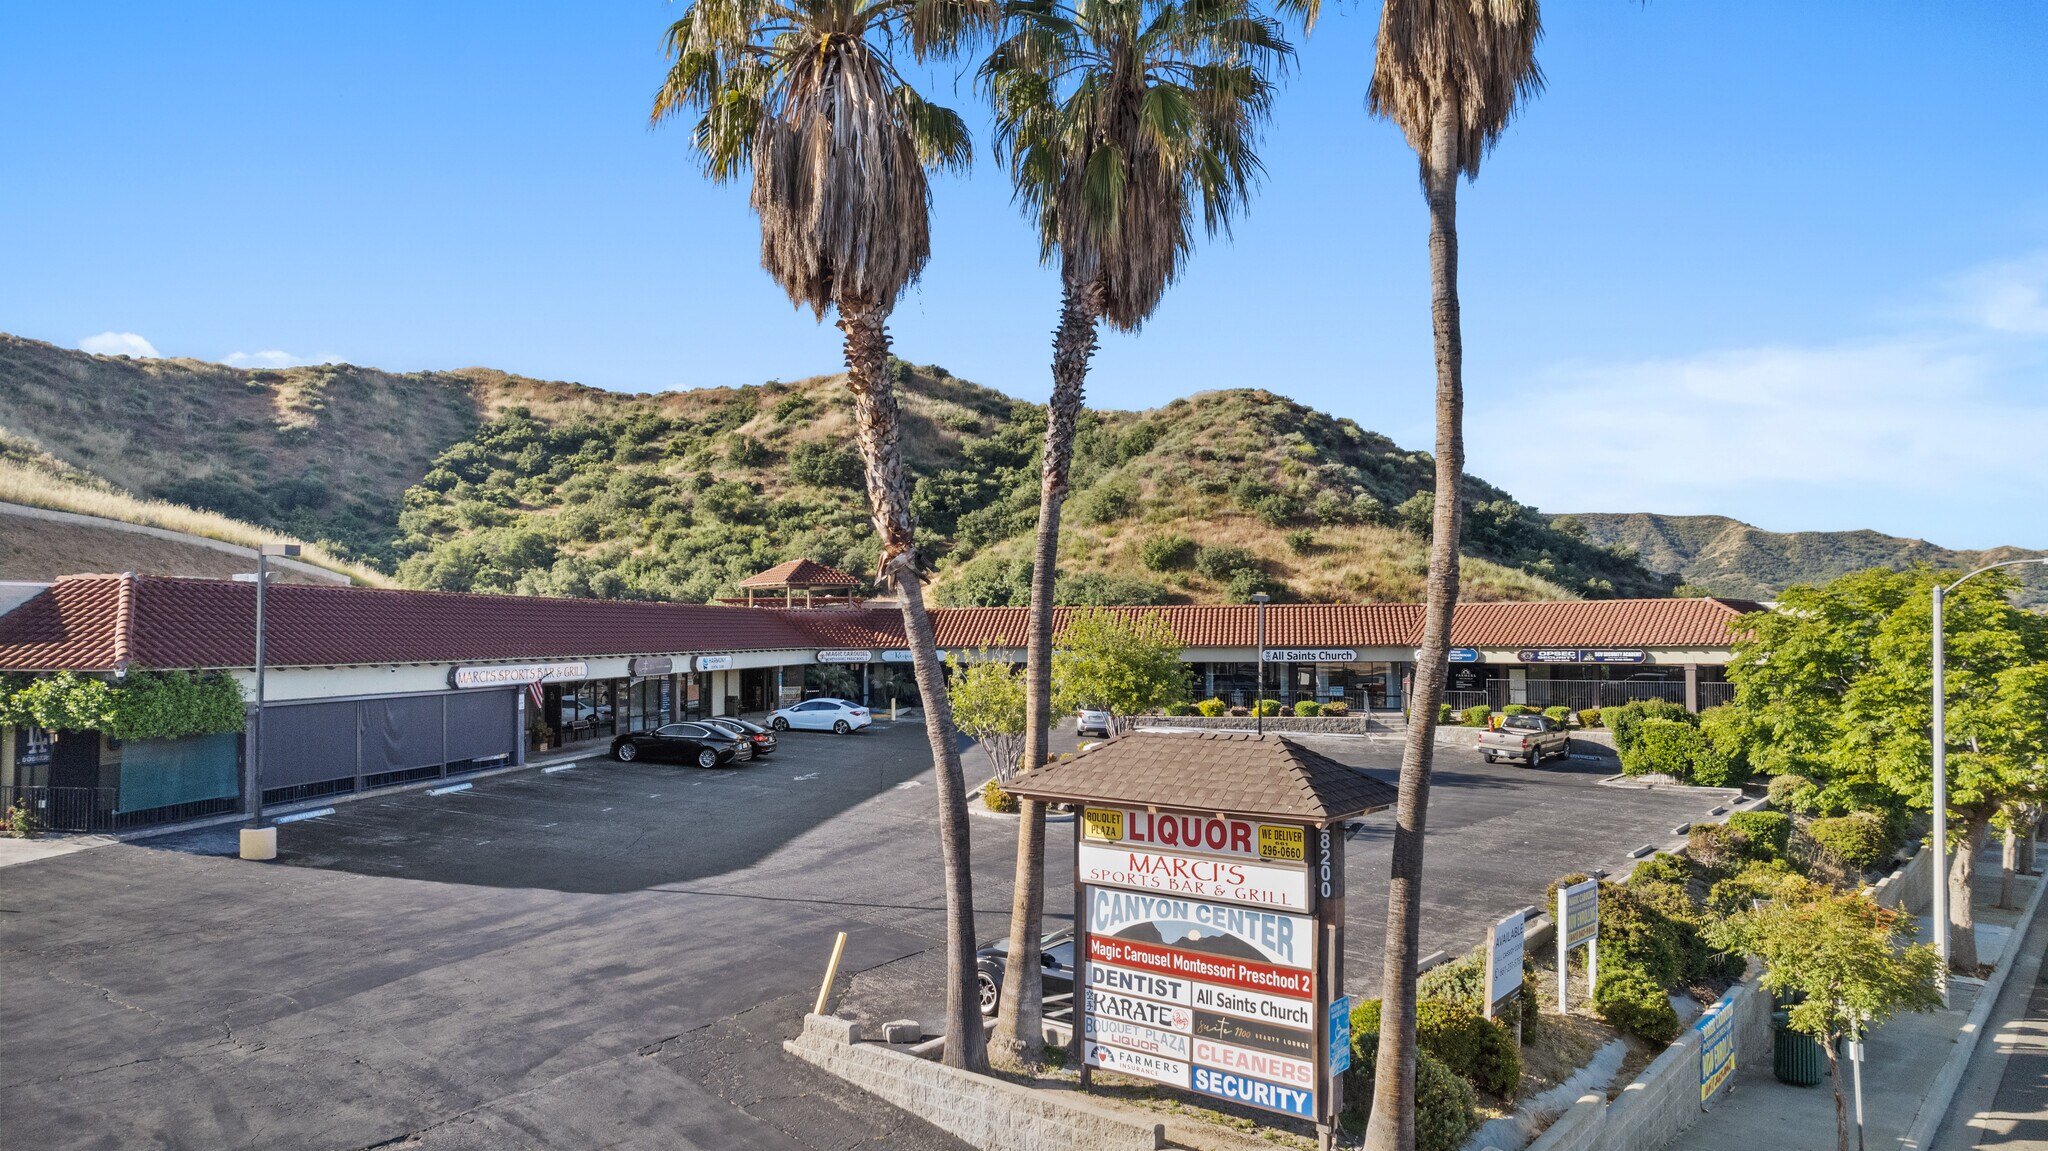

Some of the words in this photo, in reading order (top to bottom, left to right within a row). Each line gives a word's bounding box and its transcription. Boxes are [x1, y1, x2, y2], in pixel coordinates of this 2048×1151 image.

[1272, 651, 1284, 660] All
[1286, 651, 1316, 660] Saints
[1319, 651, 1352, 660] Church
[458, 671, 496, 684] MARCI'S
[499, 668, 535, 681] SPORTS
[537, 667, 555, 679] BAR
[556, 668, 563, 678] &
[563, 665, 585, 677] GRILL
[1087, 811, 1121, 825] BOUQUET
[1091, 825, 1116, 837] PLAZA
[1129, 812, 1252, 853] LIQUOR
[1261, 828, 1272, 840] WE
[1274, 829, 1302, 842] DELIVER
[1129, 853, 1245, 885] MARCI'S
[1091, 869, 1160, 888] SPORTS
[1169, 878, 1205, 894] BAR
[1214, 885, 1225, 896] &
[1235, 888, 1292, 906] GRILL
[1095, 891, 1188, 931] CANYON
[1195, 904, 1294, 963] CENTER
[1495, 922, 1524, 948] AVAILABLE
[1091, 939, 1122, 960] Magic
[1124, 945, 1171, 968] Carousel
[1173, 954, 1235, 980] Montessori
[1239, 964, 1299, 990] Preschool
[1302, 975, 1310, 992] 2
[1092, 966, 1182, 999] DENTIST
[1093, 993, 1173, 1027] KARATE
[1196, 989, 1213, 1005] All
[1216, 992, 1257, 1014] Saints
[1260, 1000, 1308, 1024] Church
[1085, 1017, 1140, 1036] BOUQUET
[1145, 1028, 1186, 1056] PLAZA
[1111, 1033, 1159, 1053] LIQUOR
[1255, 1033, 1280, 1043] BEAUTY
[1283, 1038, 1309, 1050] LOUNGE
[1119, 1051, 1179, 1074] FARMERS
[1119, 1062, 1159, 1077] INSURANCE
[1196, 1043, 1311, 1083] CLEANERS
[1195, 1068, 1308, 1113] SECURITY
